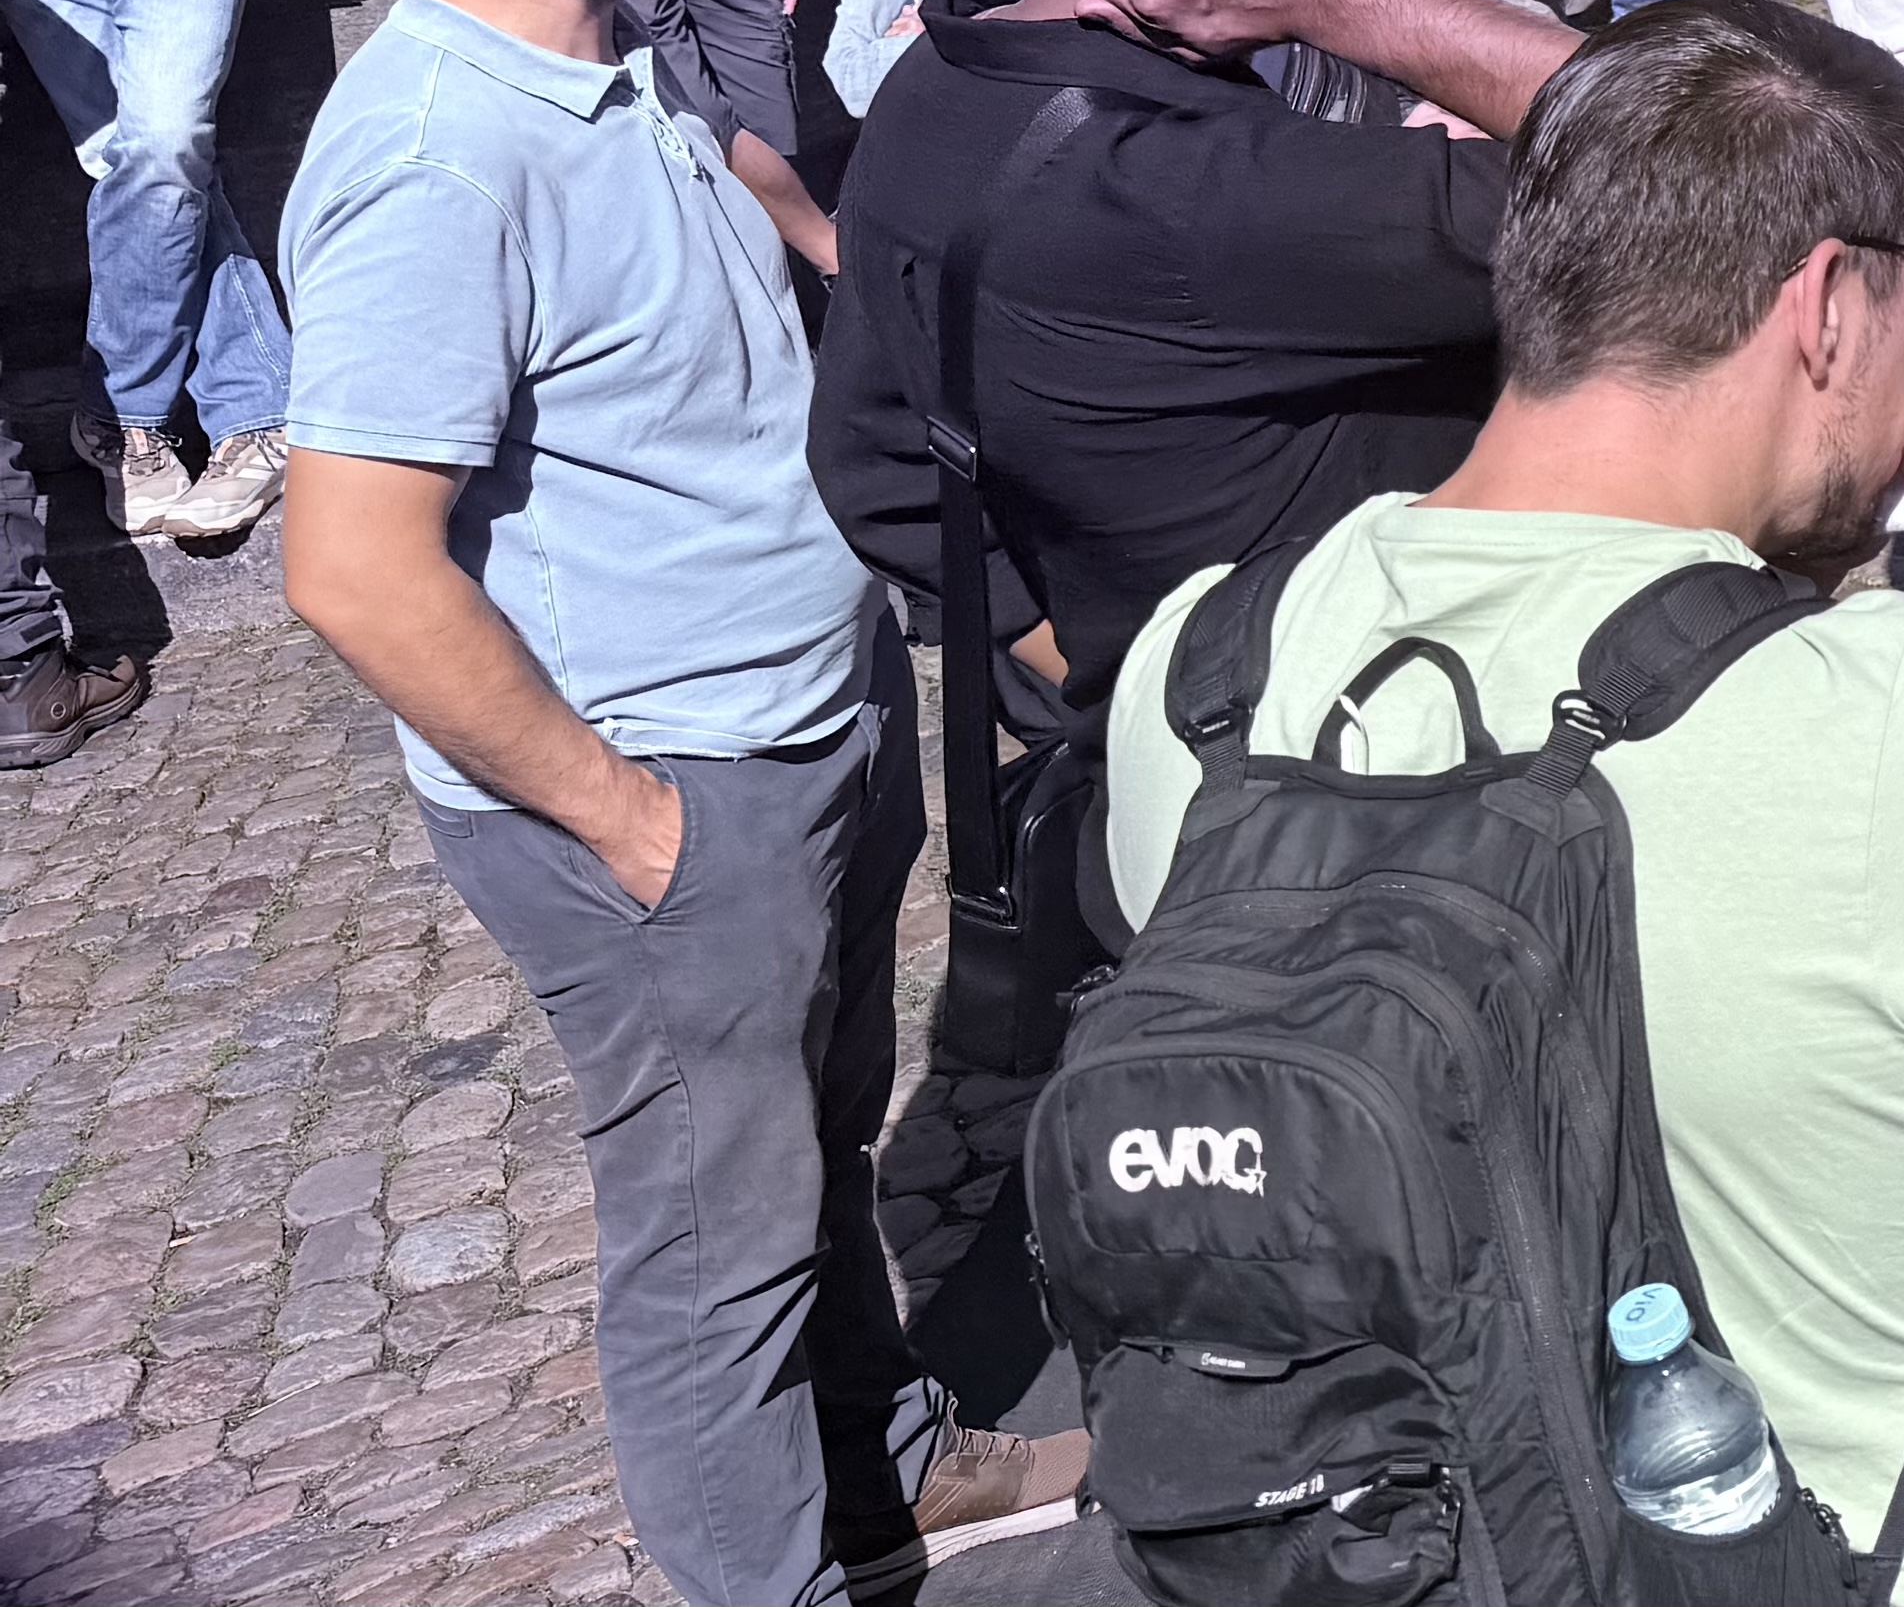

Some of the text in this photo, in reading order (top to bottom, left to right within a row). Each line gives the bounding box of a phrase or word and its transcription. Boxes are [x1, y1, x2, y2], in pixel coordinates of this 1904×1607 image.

[1109, 1126, 1267, 1197] evoc
[1254, 1473, 1325, 1508] STAGE 18
